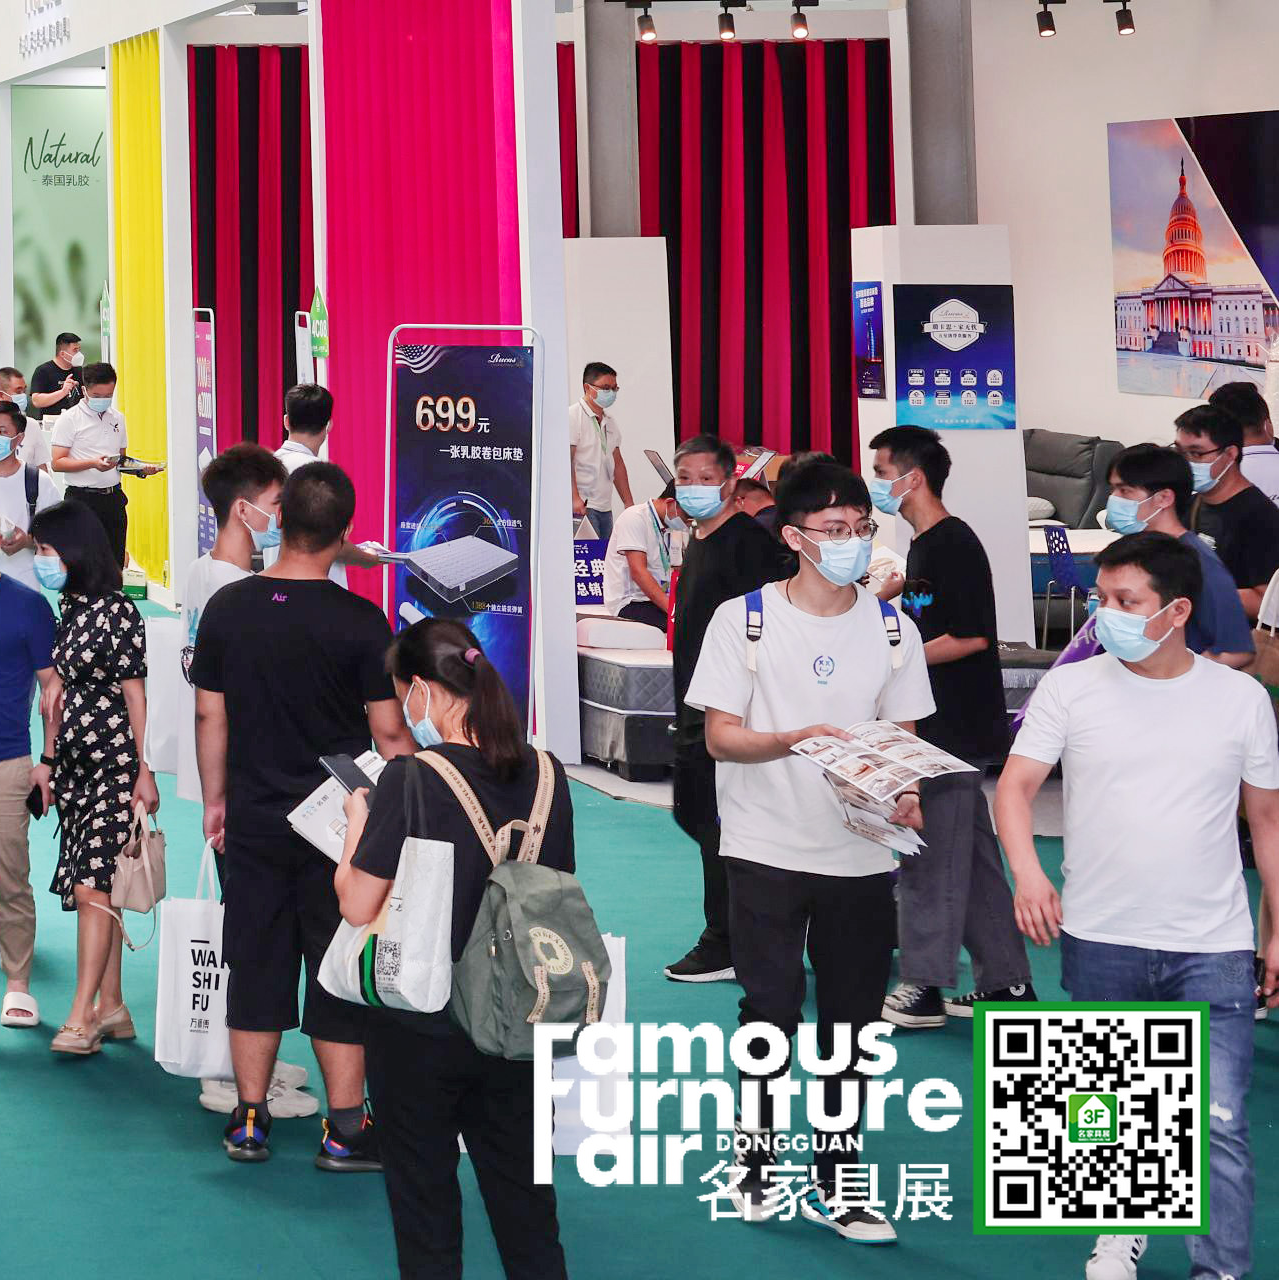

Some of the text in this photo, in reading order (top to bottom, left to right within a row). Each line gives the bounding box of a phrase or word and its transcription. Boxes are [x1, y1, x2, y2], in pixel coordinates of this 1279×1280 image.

[23, 128, 104, 174] Natural
[41, 174, 90, 187] 泰国乳胶
[487, 352, 517, 365] Rucas
[415, 394, 490, 433] 699 元
[439, 445, 524, 461] 一张乳胶卷包床垫
[574, 558, 606, 577] 经典
[271, 592, 288, 602] Air
[576, 582, 604, 597] 总销
[190, 948, 227, 969] WA
[192, 971, 220, 991] SHI
[192, 993, 210, 1011] FU
